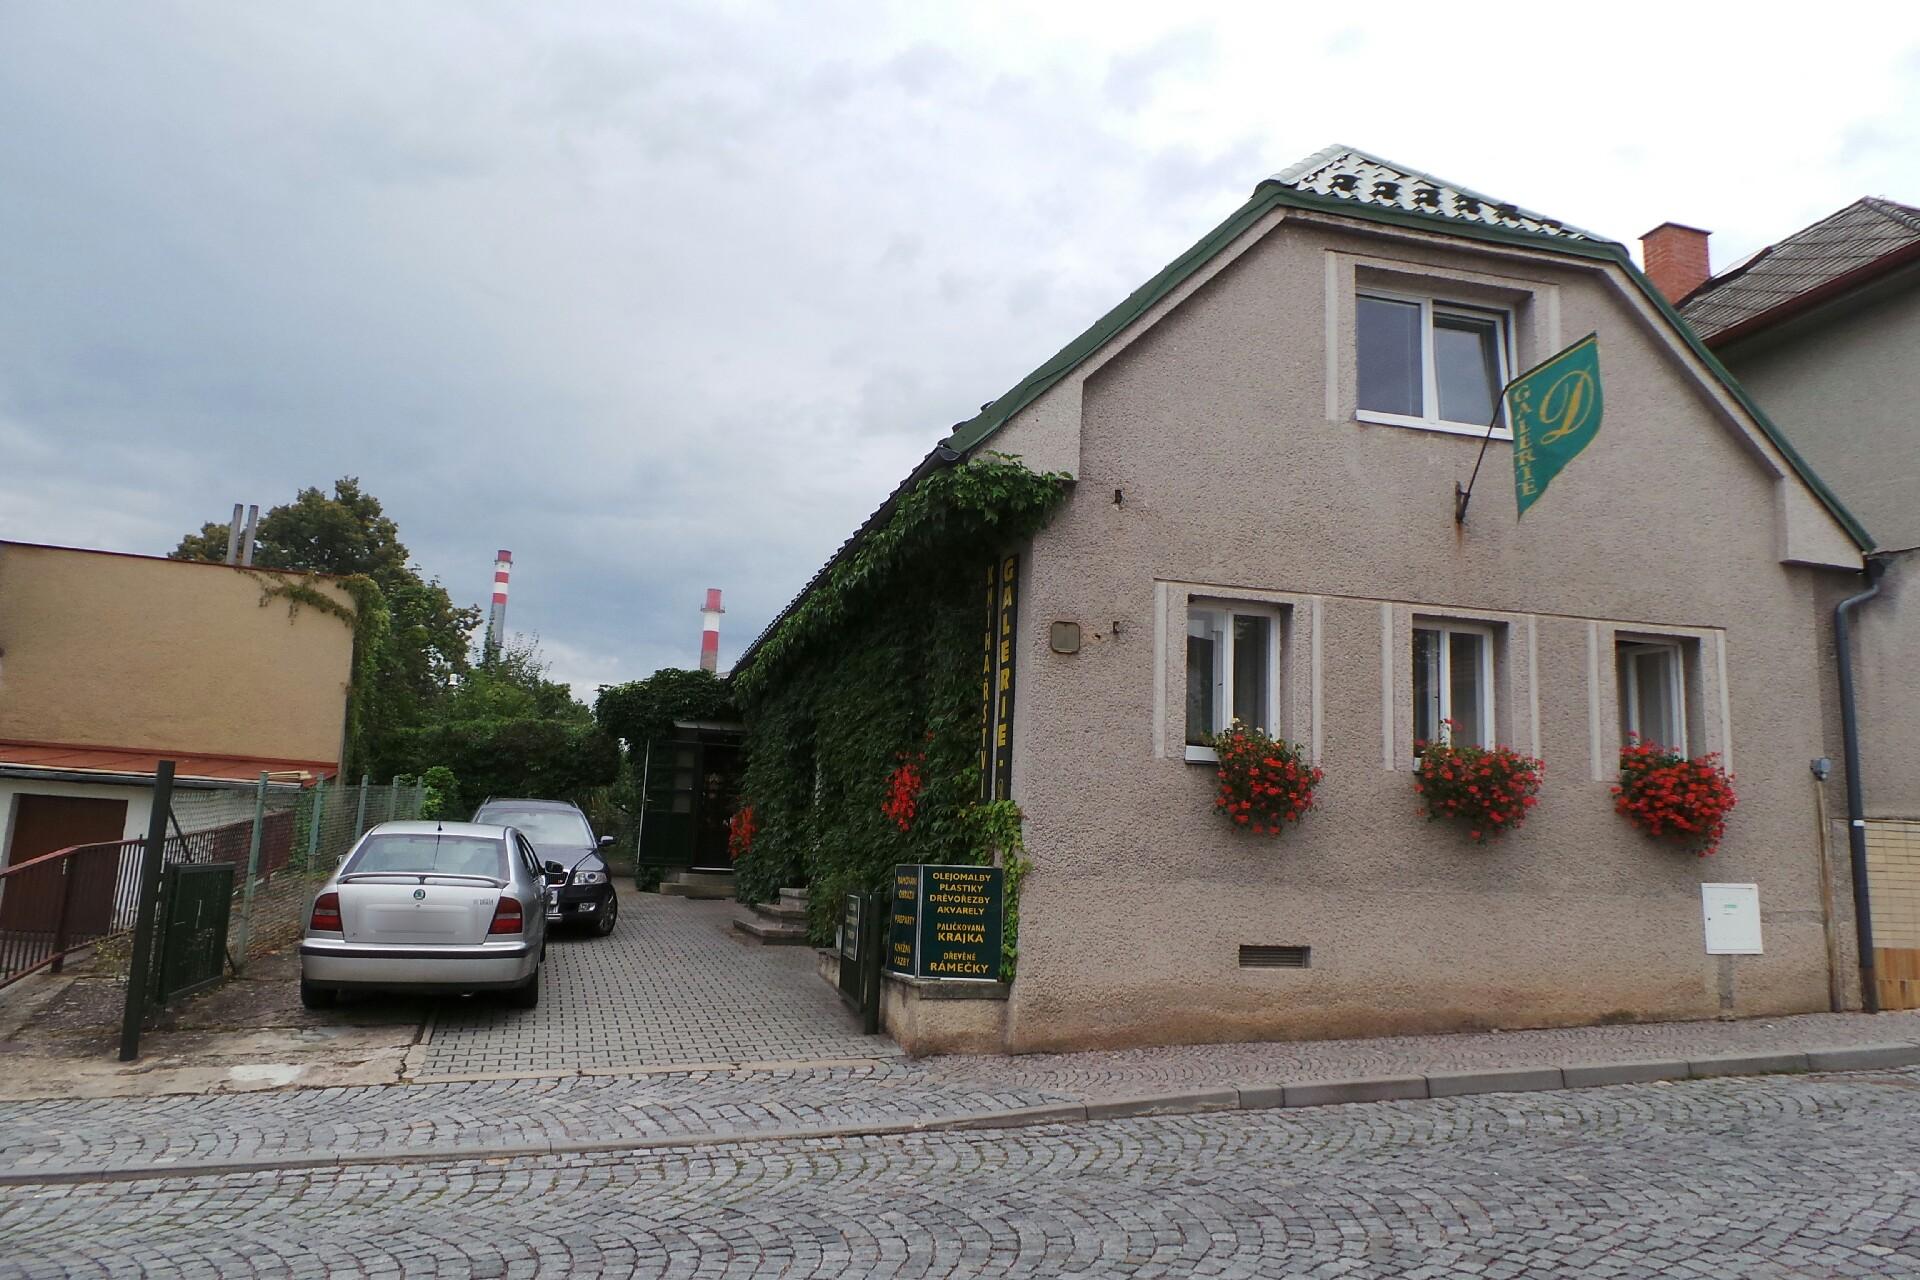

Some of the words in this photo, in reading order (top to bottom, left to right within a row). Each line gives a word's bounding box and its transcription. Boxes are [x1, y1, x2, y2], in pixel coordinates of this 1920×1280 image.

[1514, 385, 1537, 496] GALERIE
[932, 872, 991, 882] OLEJOMALBY
[939, 883, 983, 893] PLASTIKY
[937, 906, 985, 916] AKVARELY
[937, 932, 984, 944] KRAJKA
[930, 960, 989, 974] RÁMEČKY
